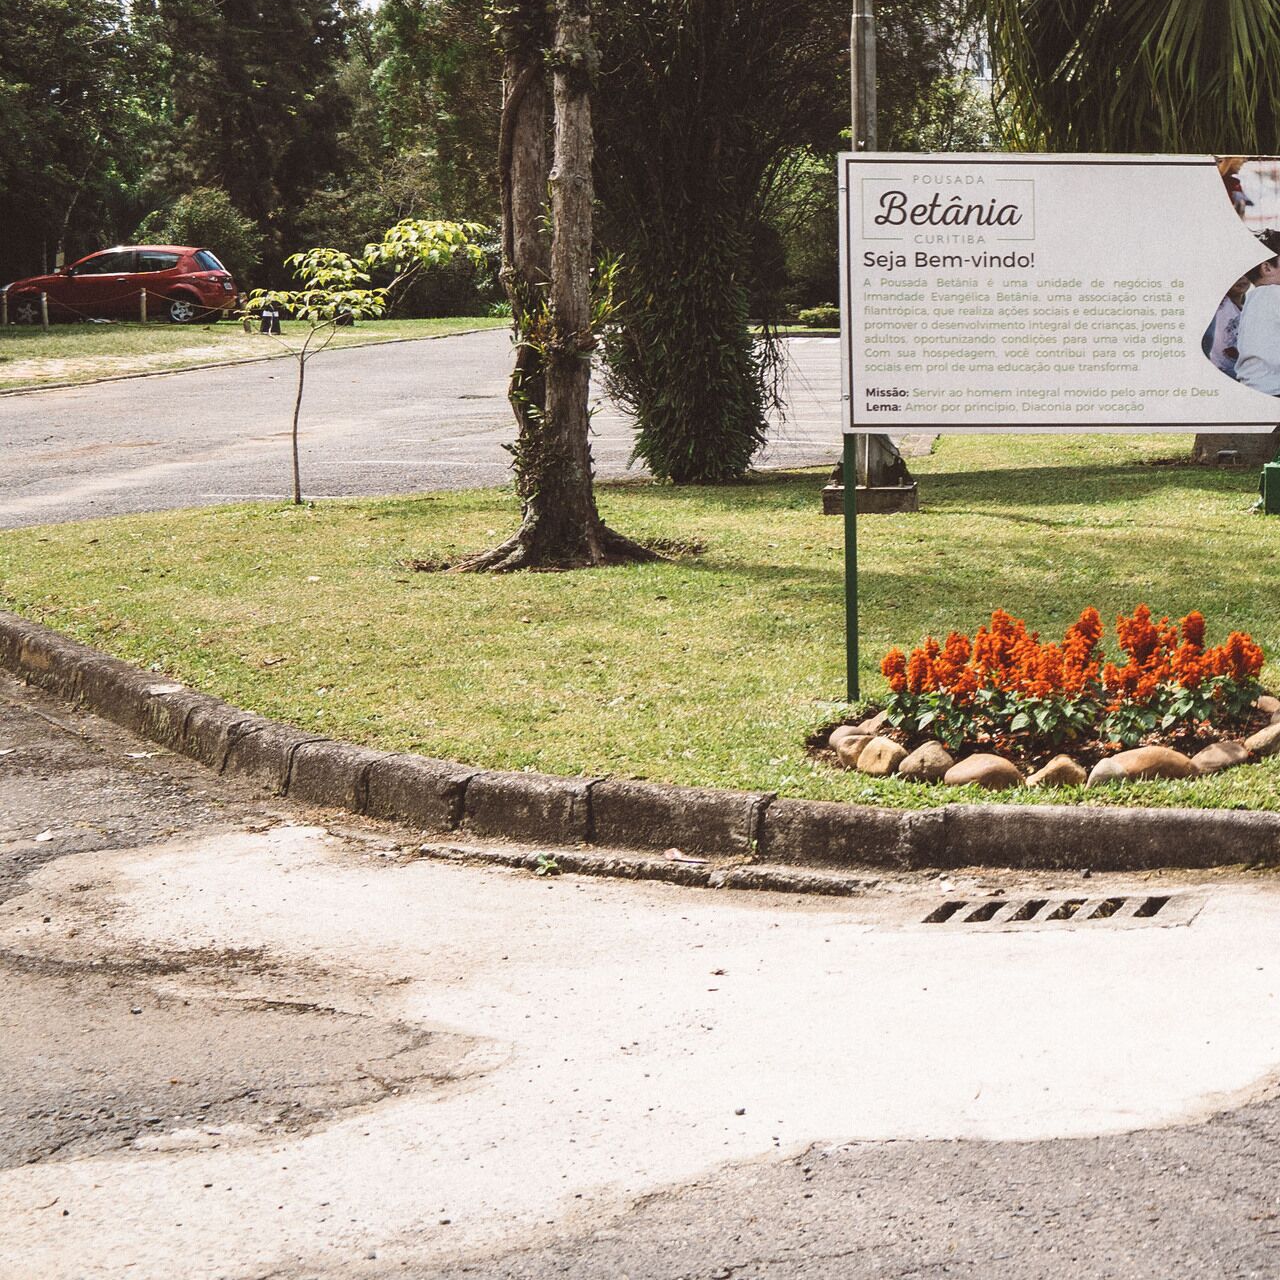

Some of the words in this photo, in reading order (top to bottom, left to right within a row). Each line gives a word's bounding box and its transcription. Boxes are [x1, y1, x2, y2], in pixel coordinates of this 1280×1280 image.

[913, 175, 984, 185] POUSADA
[874, 190, 1023, 226] Betânia
[914, 234, 986, 244] CURITIBA
[864, 250, 907, 272] Seja
[914, 250, 1035, 268] Bem-vindo!
[864, 278, 872, 287] A
[880, 277, 928, 288] Pousada
[936, 278, 979, 288] Betânia
[986, 278, 994, 288] é
[1002, 280, 1028, 288] uma
[1036, 278, 1083, 289] unidade
[1090, 278, 1105, 289] de
[1113, 277, 1162, 290] negócios
[1170, 278, 1185, 288] da
[864, 292, 925, 302] Irmandade
[930, 291, 990, 304] Evangélica
[1047, 294, 1072, 302] uma
[1078, 292, 1137, 304] associação
[1142, 292, 1173, 303] cristã
[1177, 294, 1186, 303] e
[932, 308, 955, 317] que
[958, 306, 994, 316] realiza
[998, 306, 1030, 317] ações
[1032, 307, 1070, 316] sociais
[1072, 308, 1080, 316] e
[1160, 308, 1185, 317] para
[864, 322, 918, 332] promover
[921, 322, 928, 330] o
[930, 320, 1026, 330] desenvolvimento
[1028, 320, 1071, 332] integral
[1073, 320, 1088, 330] de
[1140, 321, 1177, 332] jovens
[1178, 322, 1186, 330] e
[913, 334, 996, 346] oportunizando
[1001, 334, 1058, 345] condições
[1062, 336, 1088, 345] para
[1092, 336, 1118, 344] uma
[1123, 334, 1146, 344] vida
[864, 350, 891, 358] Com
[896, 350, 916, 358] sua
[1004, 348, 1030, 358] você
[1035, 348, 1086, 358] contribui
[1092, 350, 1117, 360] para
[1122, 350, 1136, 358] os
[1141, 347, 1186, 360] projetos
[864, 362, 902, 372] sociais
[903, 364, 923, 372] em
[926, 362, 948, 374] prol
[950, 362, 966, 372] de
[968, 364, 995, 372] uma
[996, 362, 1052, 374] educação
[1053, 364, 1076, 374] que
[866, 386, 910, 398] Missão:
[912, 388, 946, 398] Servir
[948, 390, 964, 398] ao
[966, 387, 1013, 398] homem
[1016, 387, 1060, 400] integral
[1063, 387, 1108, 398] movido
[1110, 387, 1136, 399] pelo
[1138, 388, 1170, 398] amor
[1172, 387, 1188, 398] de
[1190, 386, 1220, 398] Deus
[866, 404, 902, 412] Lema:
[904, 402, 938, 412] Amor
[940, 404, 961, 414] por
[1021, 402, 1072, 412] Diaconia
[1075, 404, 1095, 413] por
[1098, 401, 1145, 414] vocação
